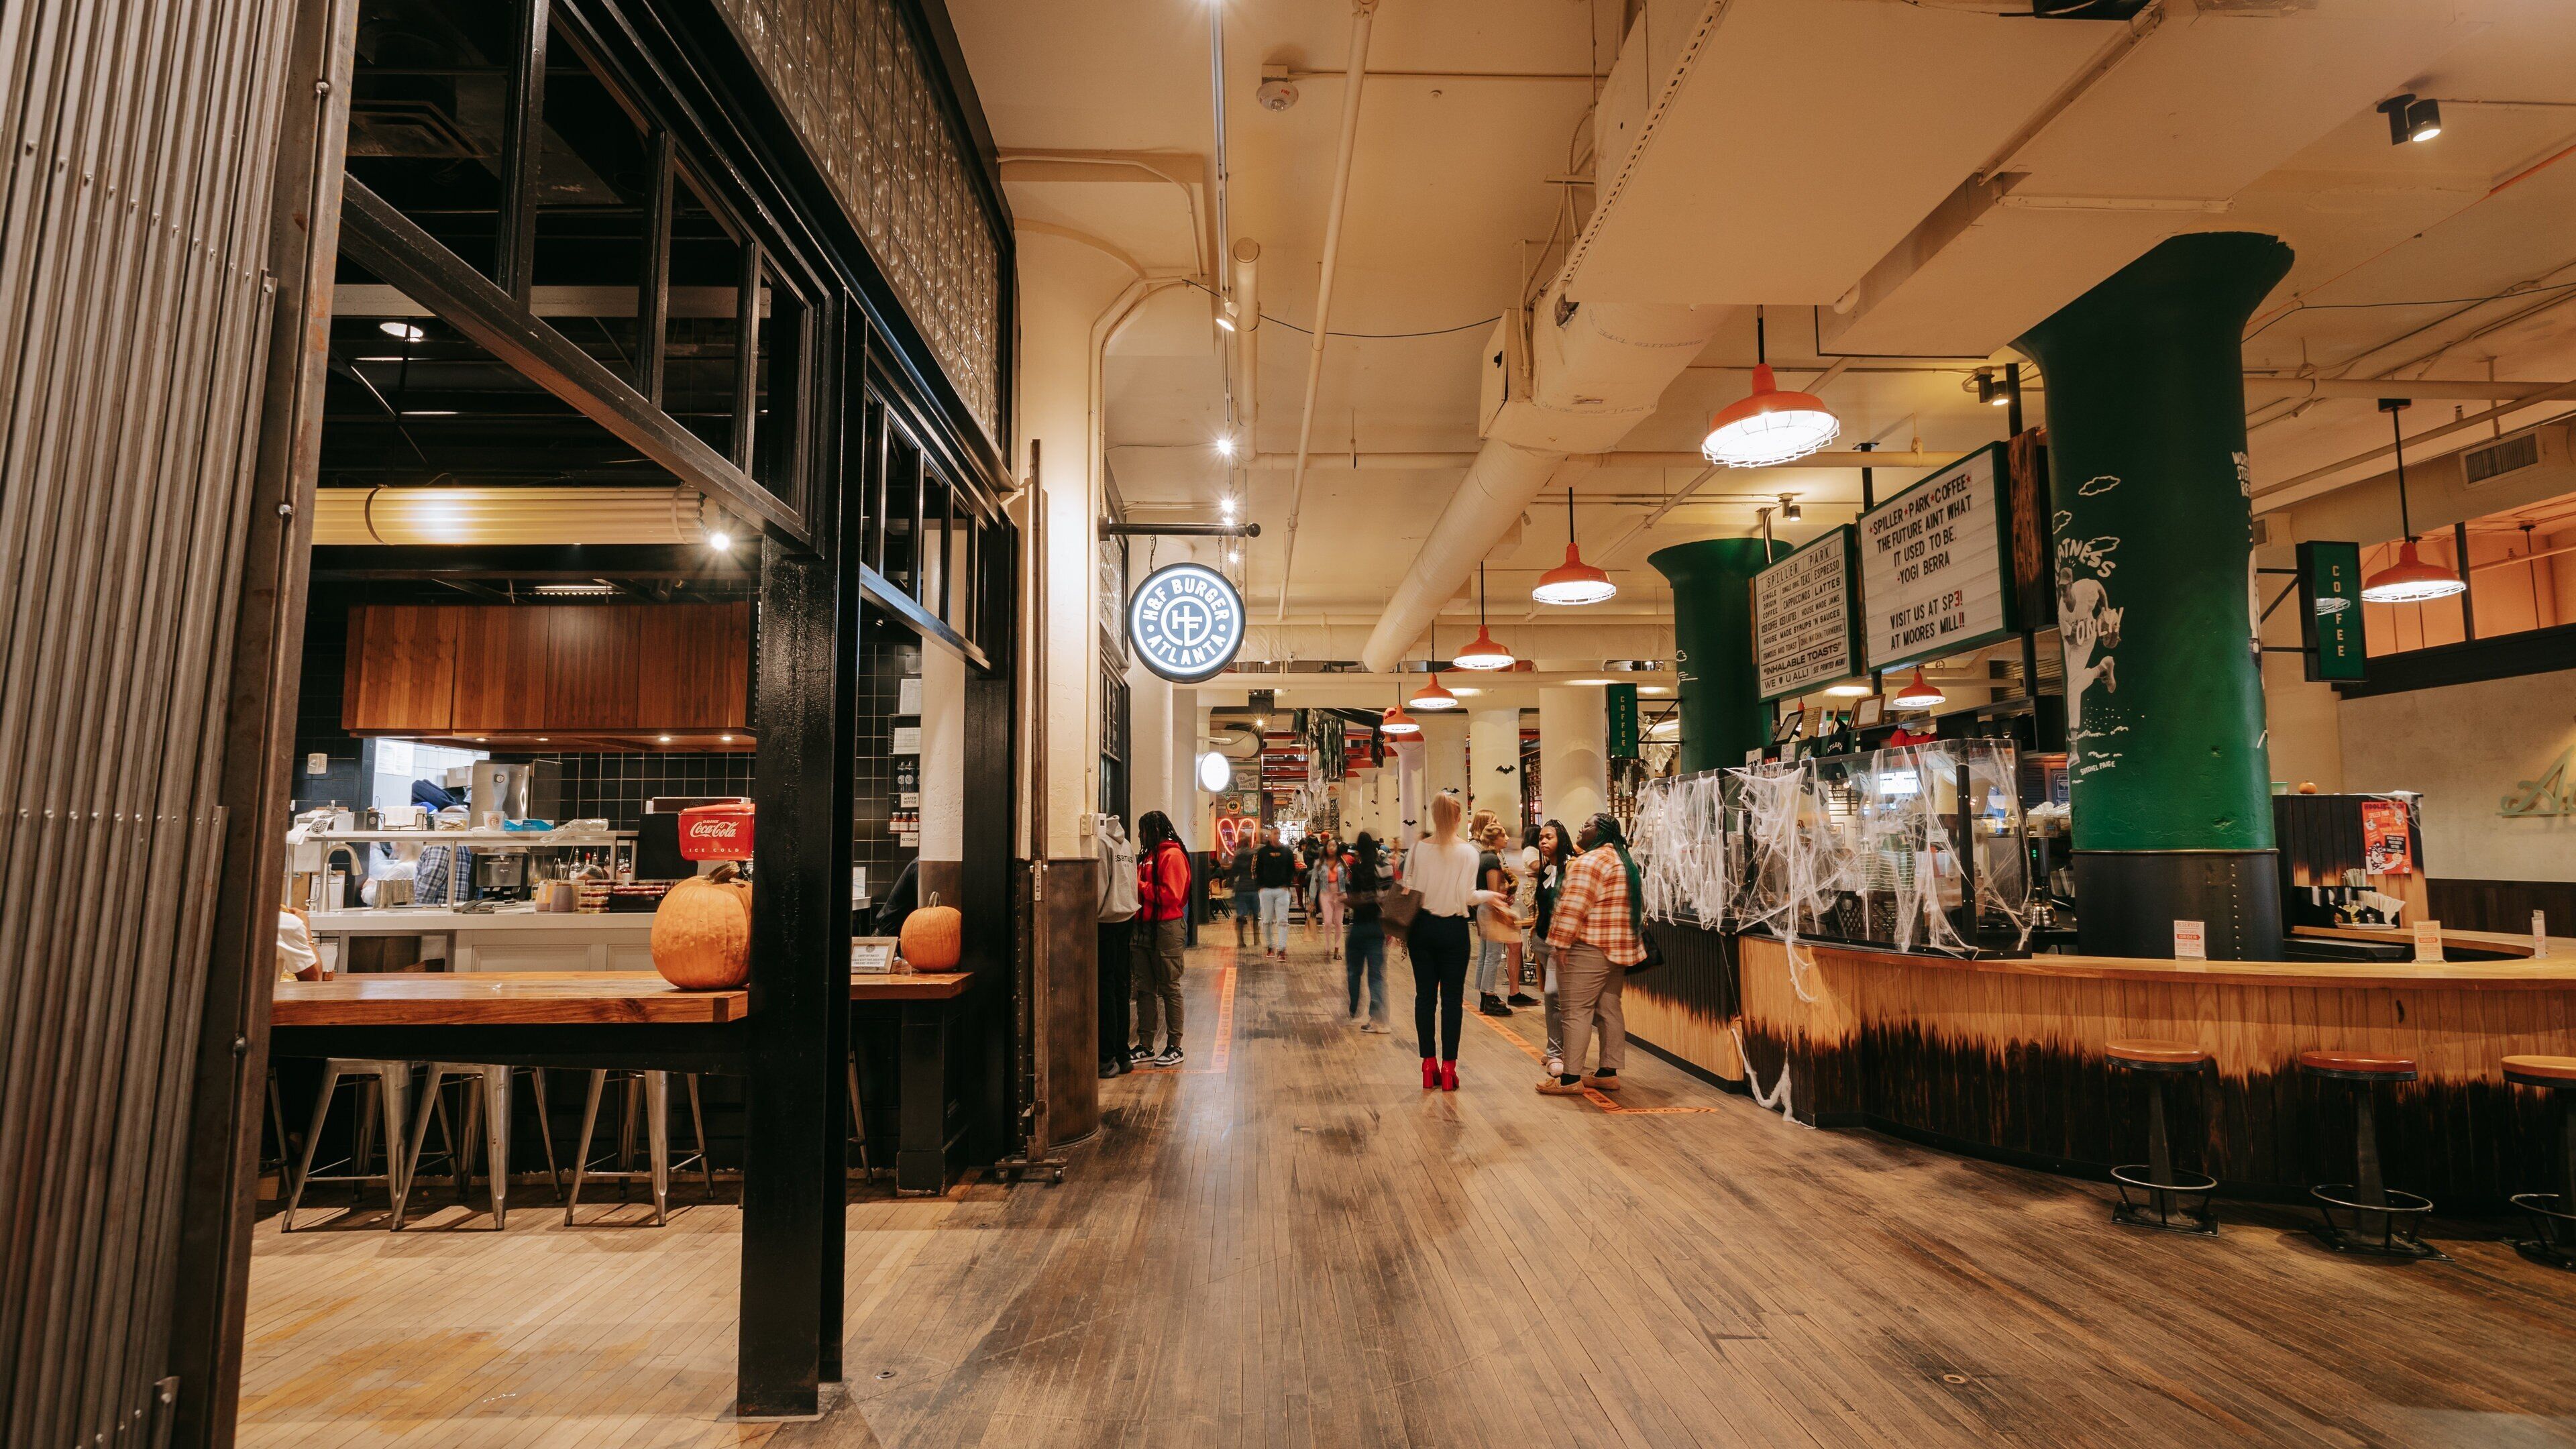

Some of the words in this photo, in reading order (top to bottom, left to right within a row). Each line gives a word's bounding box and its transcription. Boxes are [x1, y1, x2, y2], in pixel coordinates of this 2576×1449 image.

[1873, 508, 1903, 535] SPILLER
[1909, 493, 1931, 518] PARK
[1935, 474, 1967, 503] COFFEE
[1877, 533, 1891, 553] THE
[1892, 519, 1923, 547] FUTURE
[1925, 508, 1944, 532] AINT
[1947, 494, 1972, 521] WHAT
[1894, 551, 1901, 568] IT
[1904, 540, 1925, 561] USED
[1929, 533, 1941, 551] TO
[1767, 563, 1798, 588] SPILLER
[1809, 547, 1829, 567] PARK
[1814, 559, 1839, 580] ESPRESSO
[1923, 551, 1950, 576] BERRA
[1801, 573, 1811, 586] TEAS
[1815, 577, 1840, 596] LATTES
[1142, 586, 1167, 621] H&F
[1171, 578, 1230, 621] BURGER
[1763, 590, 1776, 602] SINGLE
[1763, 599, 1776, 610] ORIGIN
[1783, 590, 1811, 610] CAPPUCCINOS
[1801, 606, 1814, 616] HOUSE
[1816, 600, 1827, 610] MADE
[1829, 594, 1840, 605] JAMS
[1763, 607, 1778, 619] COFFEE
[1890, 608, 1911, 630] VISIT
[1913, 604, 1925, 621] US
[1928, 598, 1939, 617] AT
[1942, 590, 1963, 611] SP3!
[2332, 566, 2345, 657] COFFEE
[1764, 634, 1777, 645] HOUSE
[1780, 628, 1792, 639] MADE
[1794, 620, 1811, 633] SYRUPS
[1820, 608, 1840, 623] SAUCES
[1891, 633, 1900, 651] AT
[1903, 622, 1935, 647] MOORES
[1940, 612, 1965, 635] MILL!!
[1146, 634, 1226, 665] ATLANTA
[1786, 641, 1797, 651] TOAST
[1764, 679, 1776, 689] WE
[1786, 674, 1791, 683] U
[690, 821, 739, 838] Coca-Cola
